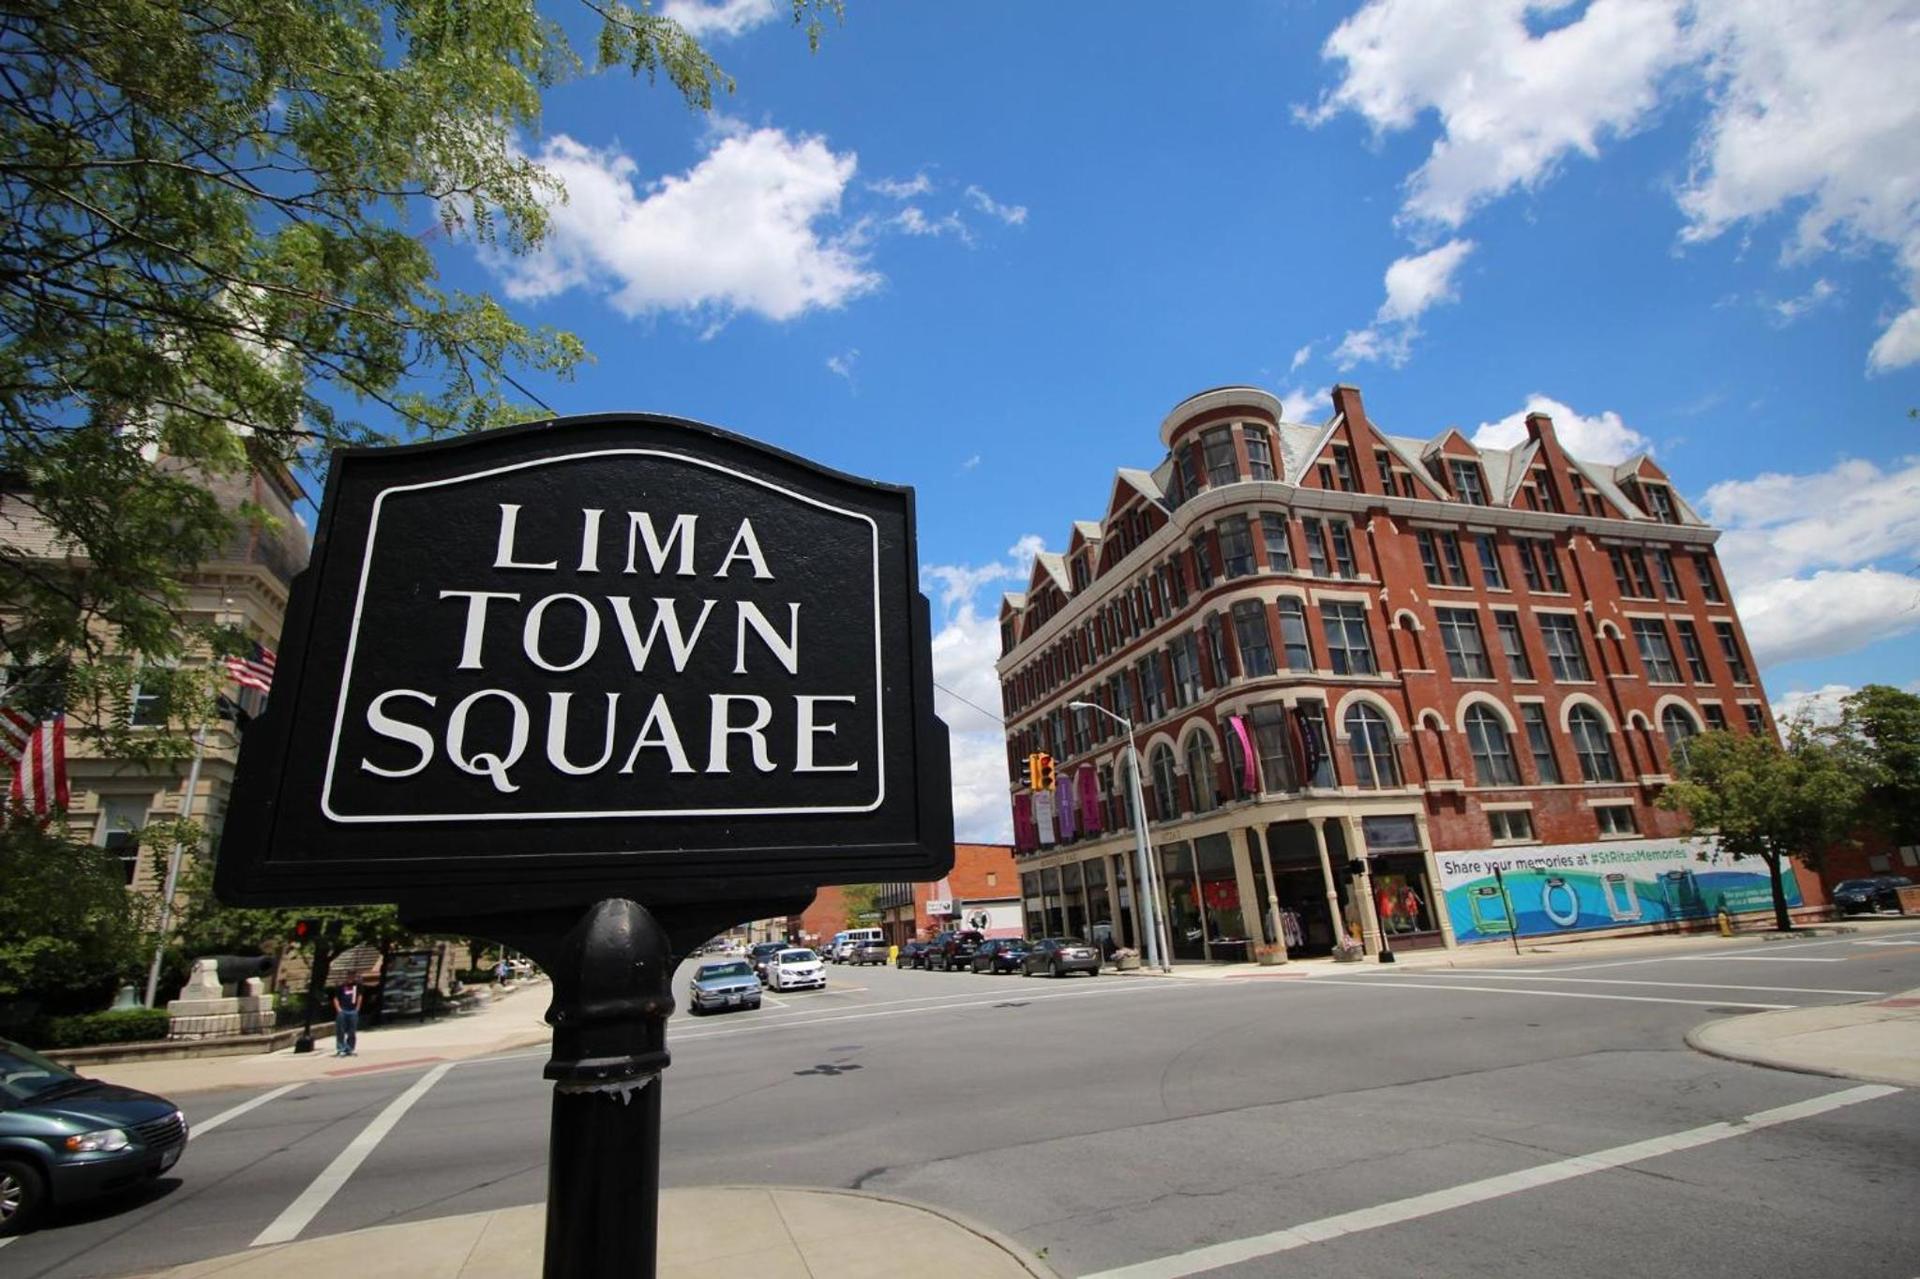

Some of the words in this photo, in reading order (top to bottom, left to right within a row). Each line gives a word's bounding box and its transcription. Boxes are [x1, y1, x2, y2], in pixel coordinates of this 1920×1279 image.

[493, 503, 775, 580] LIMA
[439, 590, 801, 675] TOWN
[361, 688, 859, 793] SQUARE
[1444, 860, 1480, 875] Share
[1484, 859, 1512, 874] your
[1516, 854, 1574, 870] memories
[1577, 853, 1588, 866] at
[1591, 847, 1687, 864] #StRitasMemories
